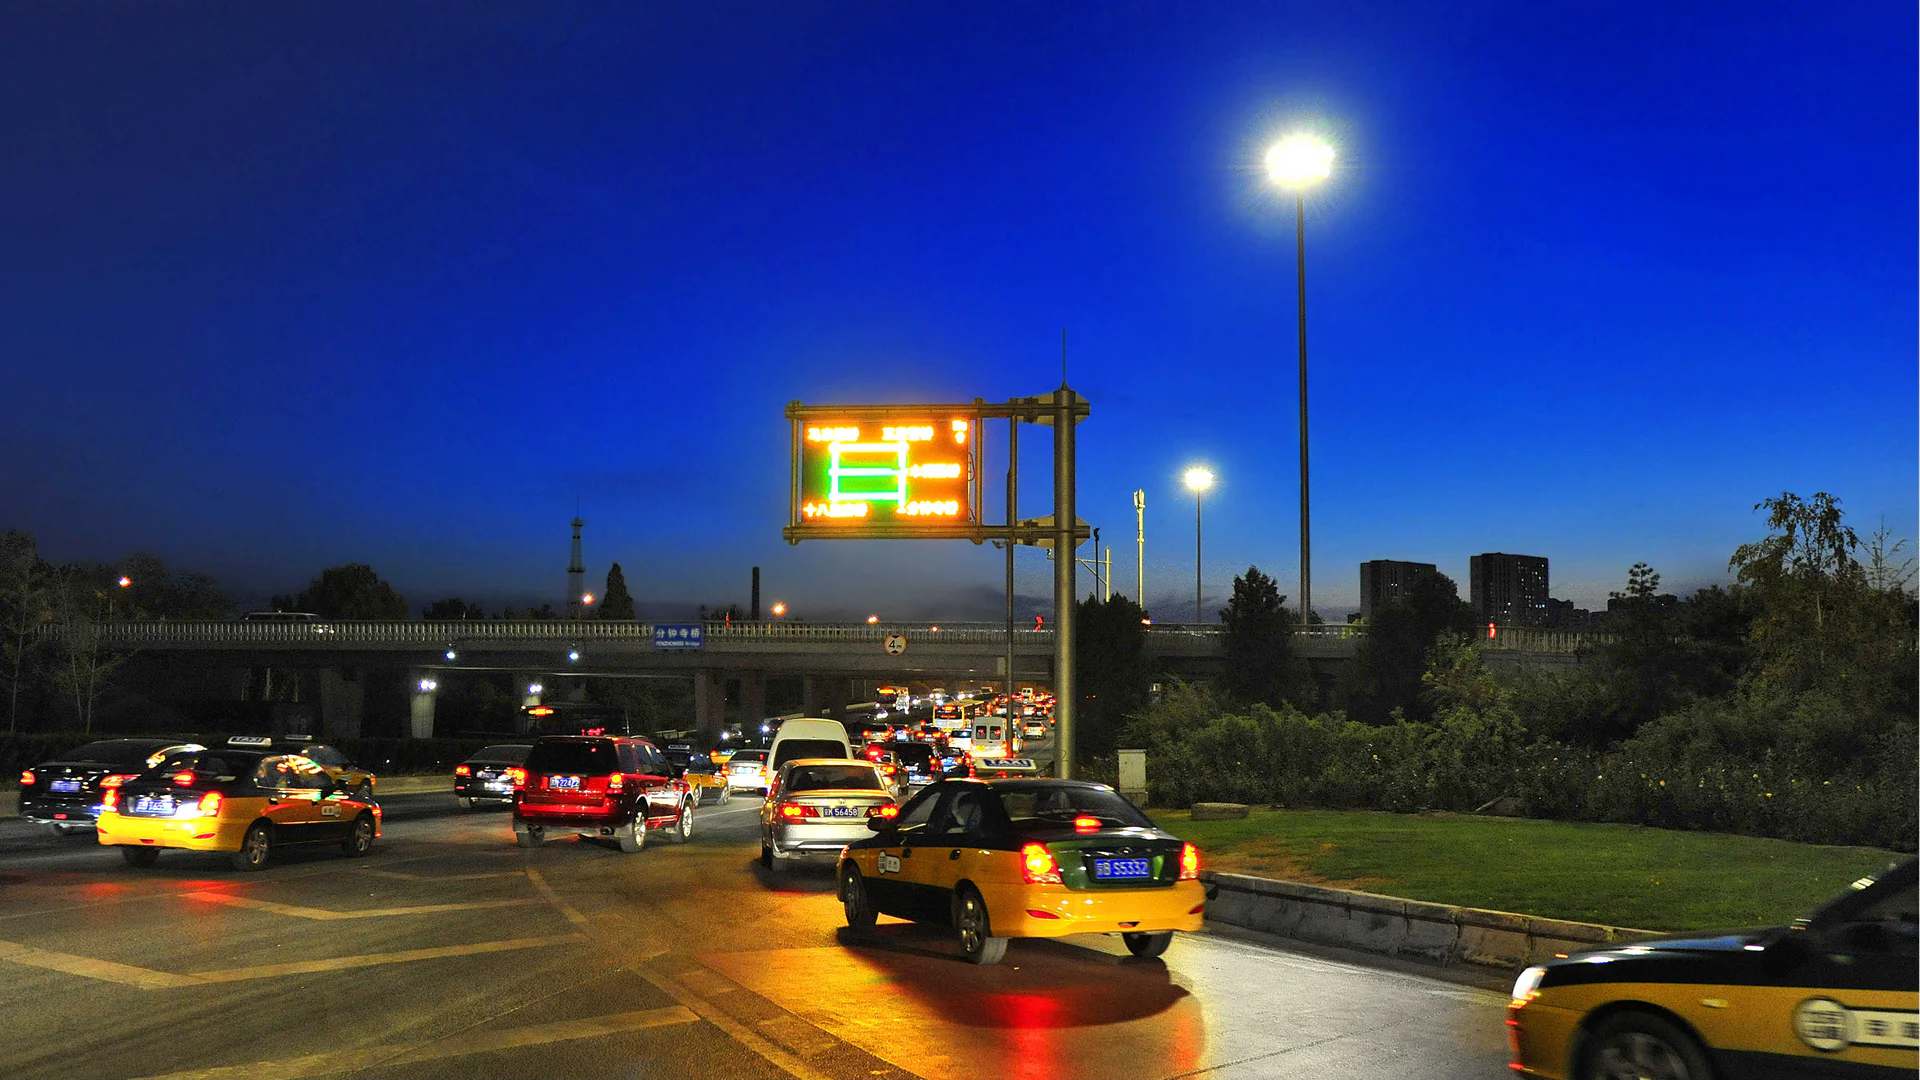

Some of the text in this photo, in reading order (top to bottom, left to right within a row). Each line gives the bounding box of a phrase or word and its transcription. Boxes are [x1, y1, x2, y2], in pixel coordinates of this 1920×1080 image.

[656, 628, 700, 639] 分钟寺桥
[1113, 861, 1148, 875] S5332
